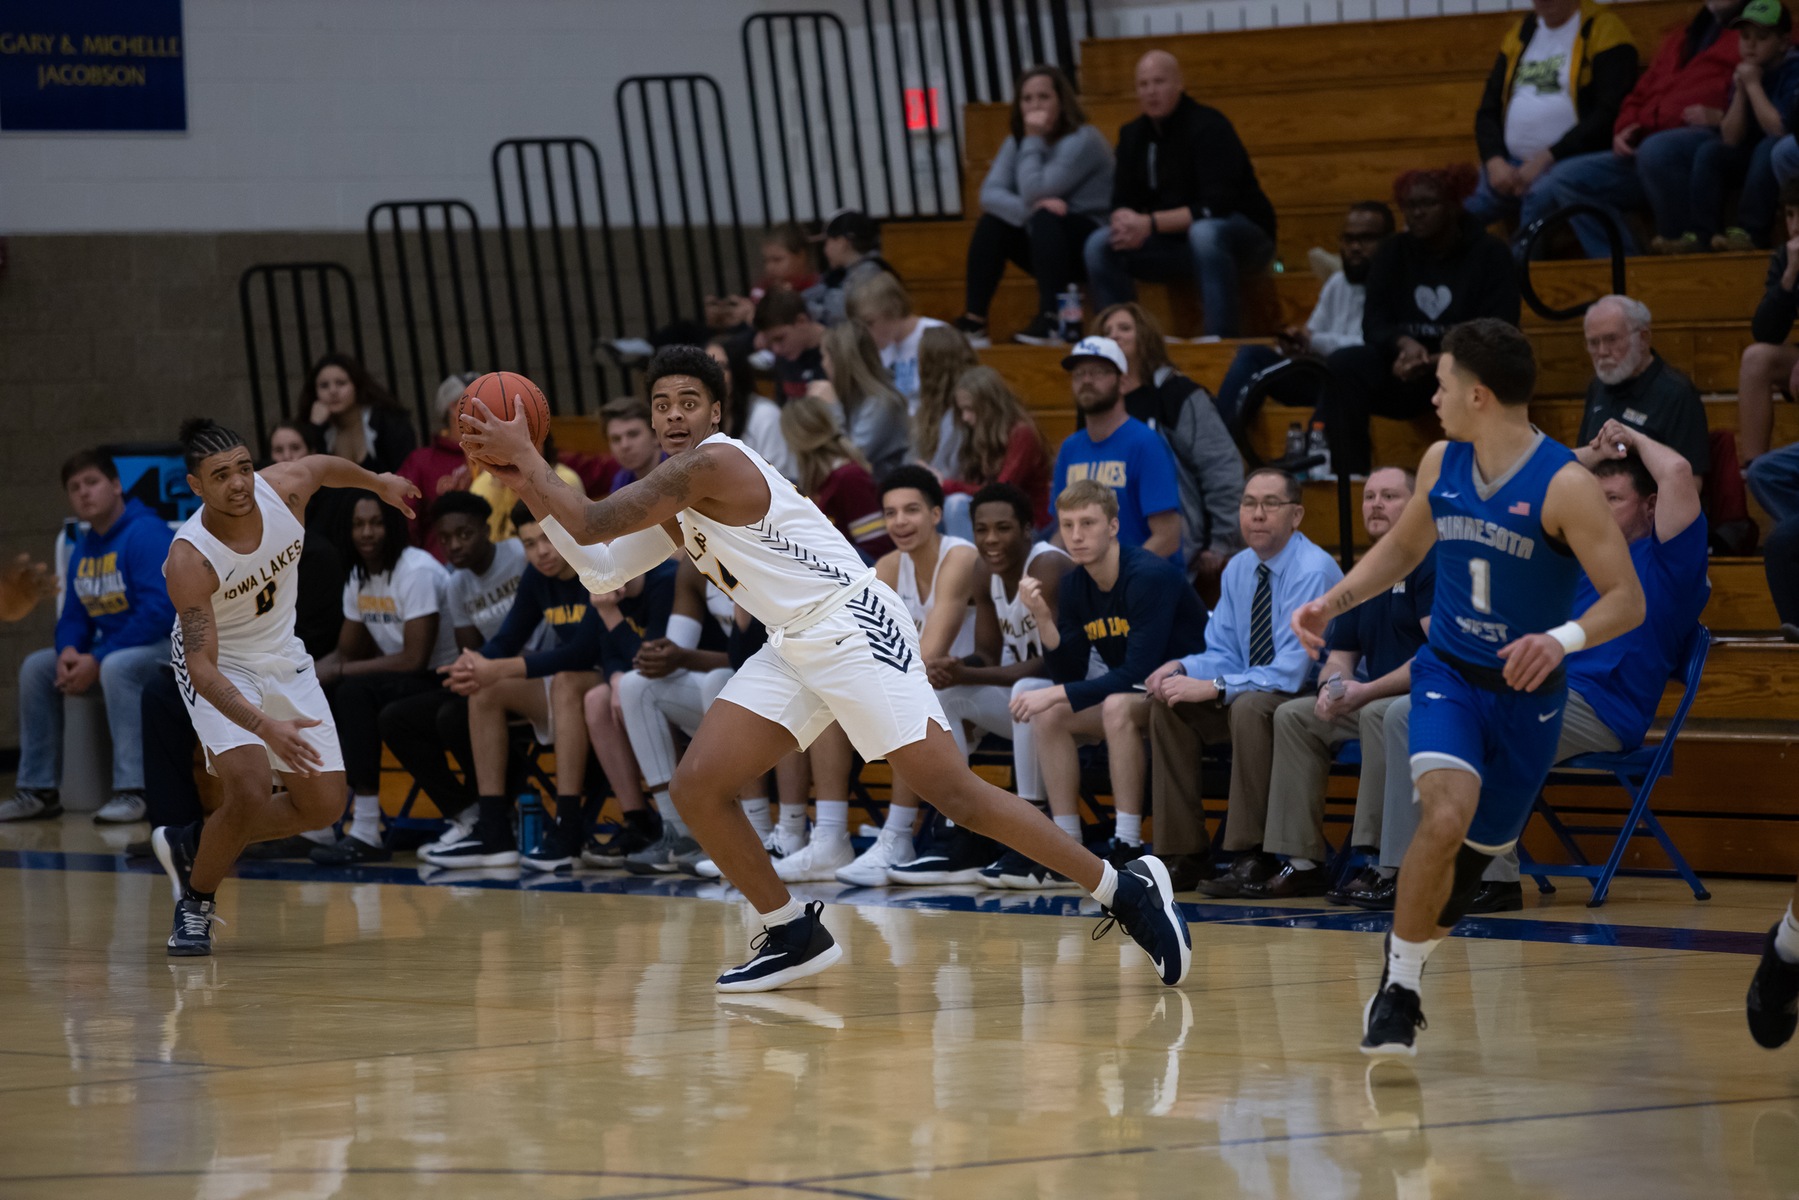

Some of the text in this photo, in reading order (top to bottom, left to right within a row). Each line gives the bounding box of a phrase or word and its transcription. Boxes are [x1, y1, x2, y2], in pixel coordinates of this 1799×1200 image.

[0, 33, 180, 58] GARY & MICHELLE
[38, 63, 147, 91] JACOBSON
[1436, 515, 1535, 560] MINNESOTA
[224, 539, 301, 600] IOWA LAKES
[1468, 556, 1492, 615] 1
[1455, 615, 1509, 643] WEST
